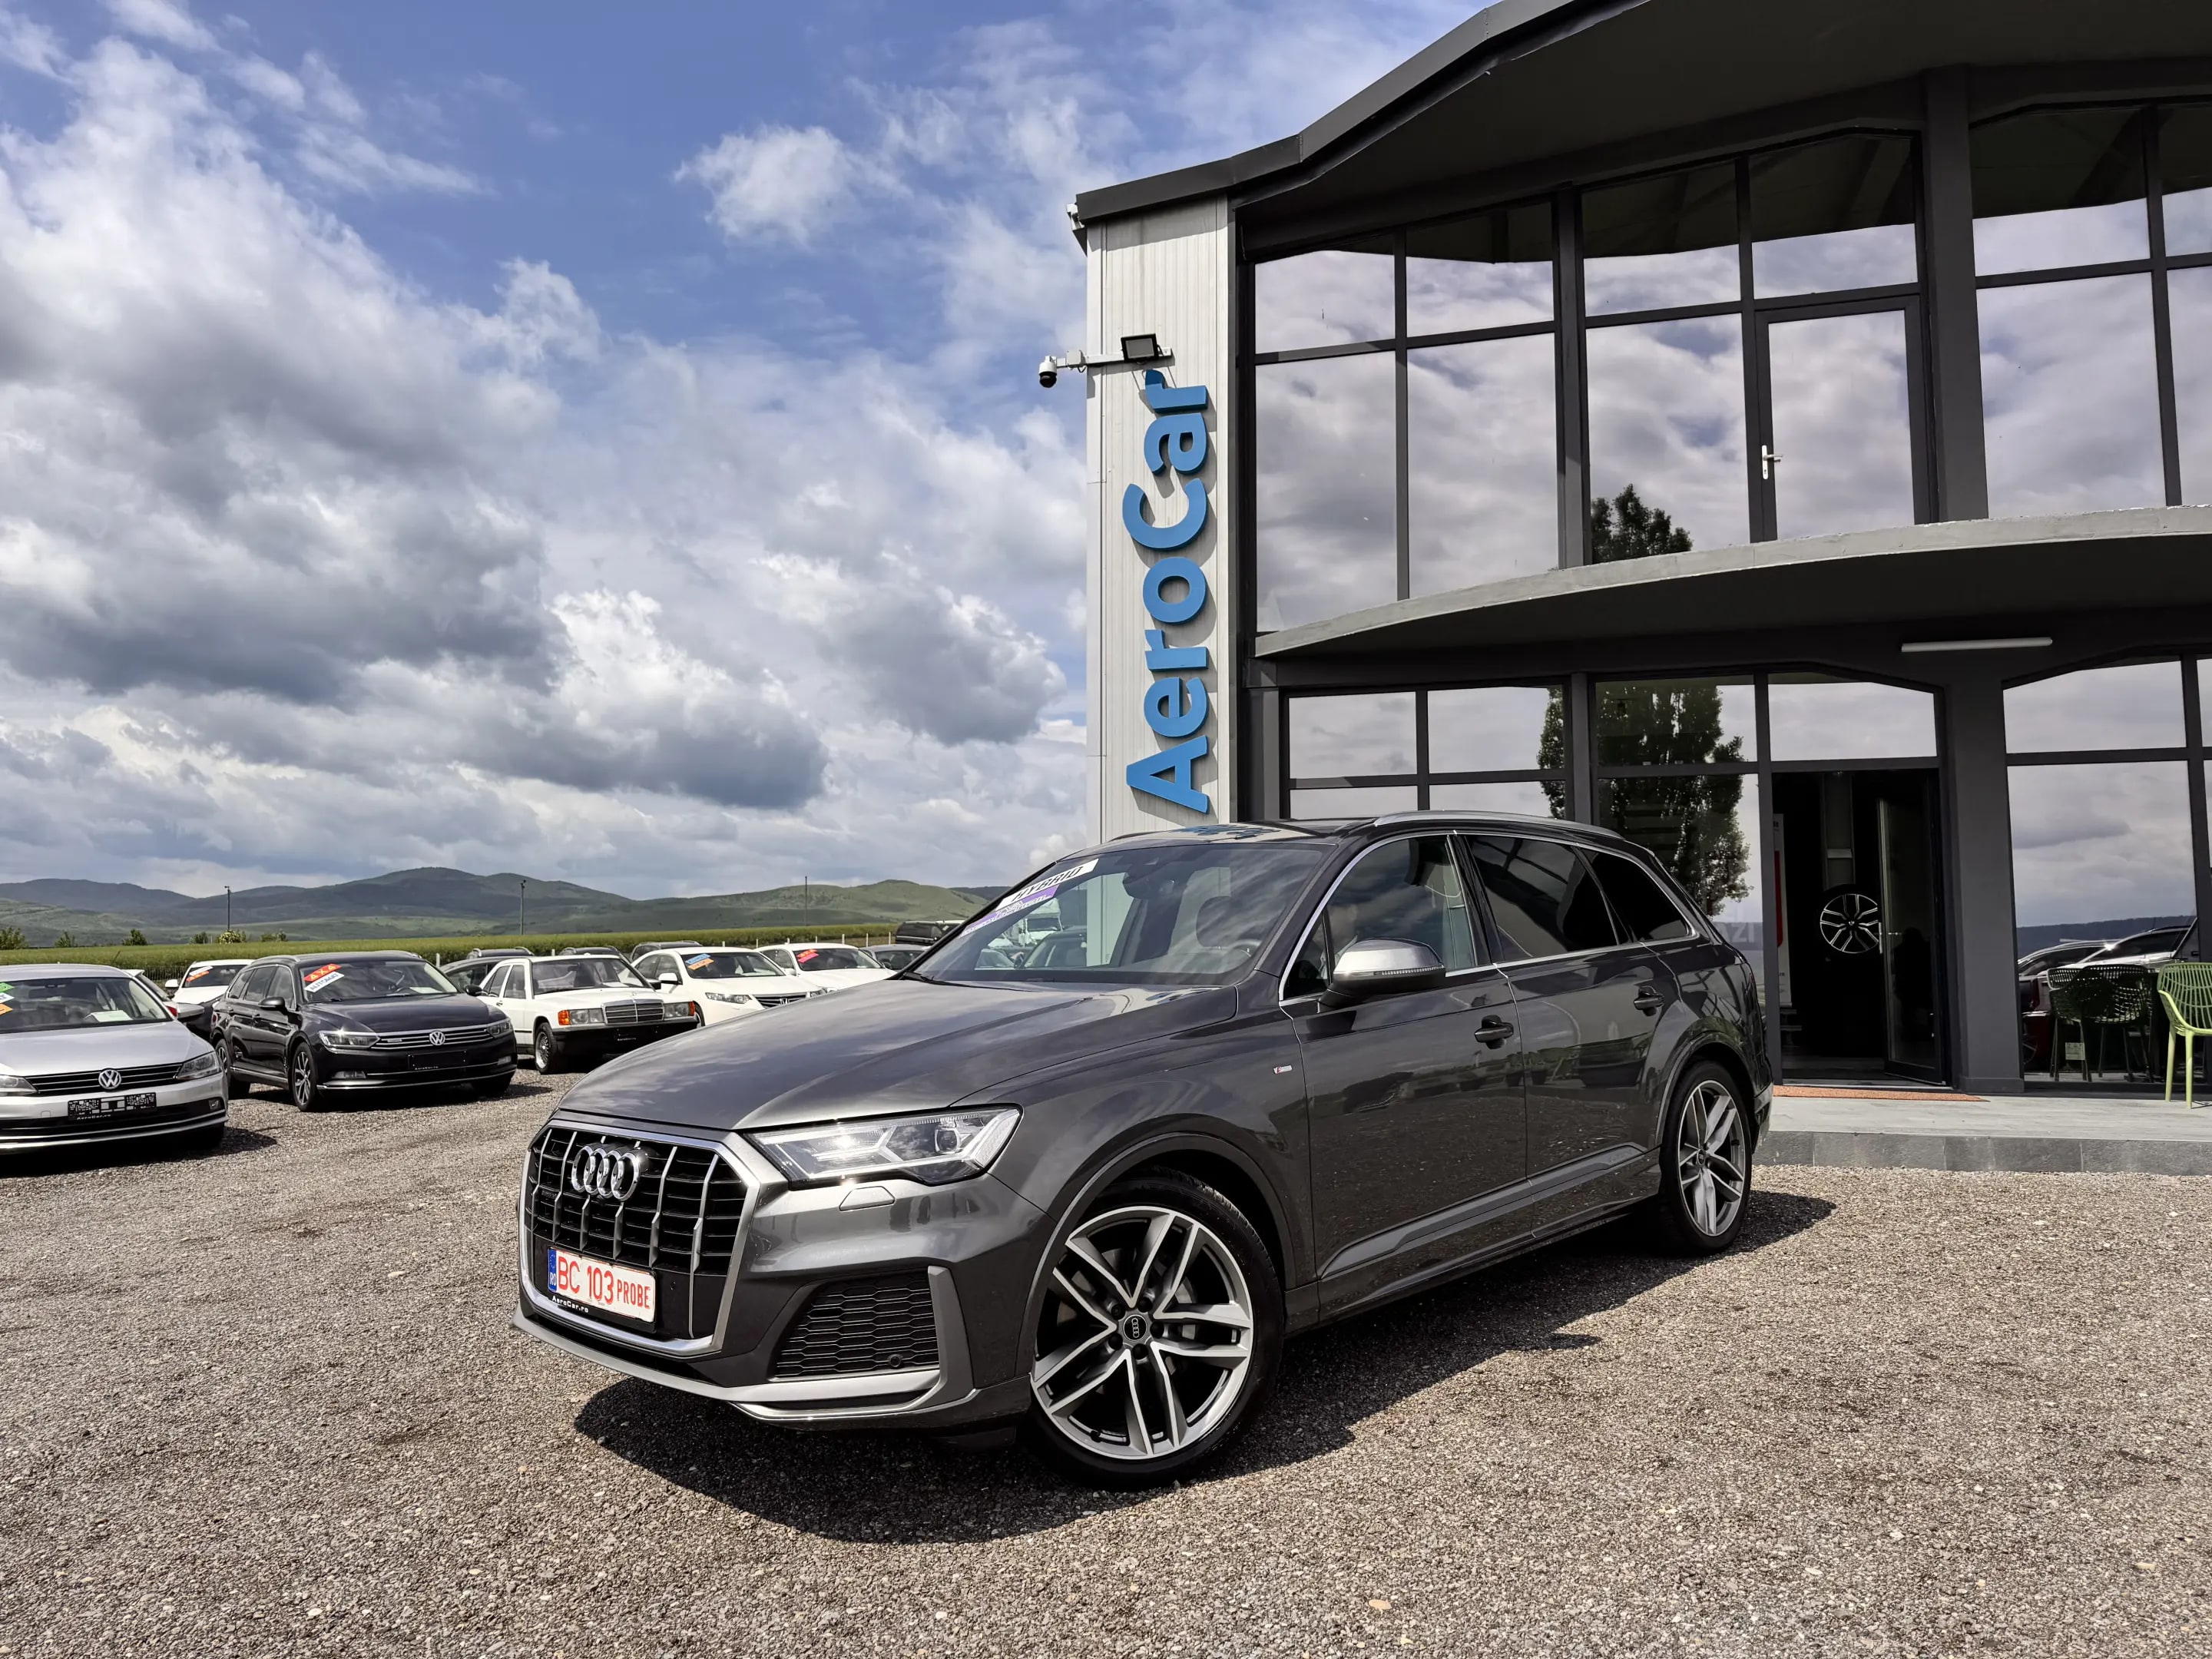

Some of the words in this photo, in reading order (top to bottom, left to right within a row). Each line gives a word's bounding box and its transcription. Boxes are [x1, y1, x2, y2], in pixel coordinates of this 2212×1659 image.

[1122, 369, 1208, 814] AeroCar
[1011, 866, 1084, 902] HYBRID
[550, 1271, 557, 1286] RO
[558, 1255, 581, 1294] BC
[587, 1265, 614, 1304] 103
[617, 1278, 651, 1309] PROBE
[552, 1295, 589, 1313] AeroCar.ro
